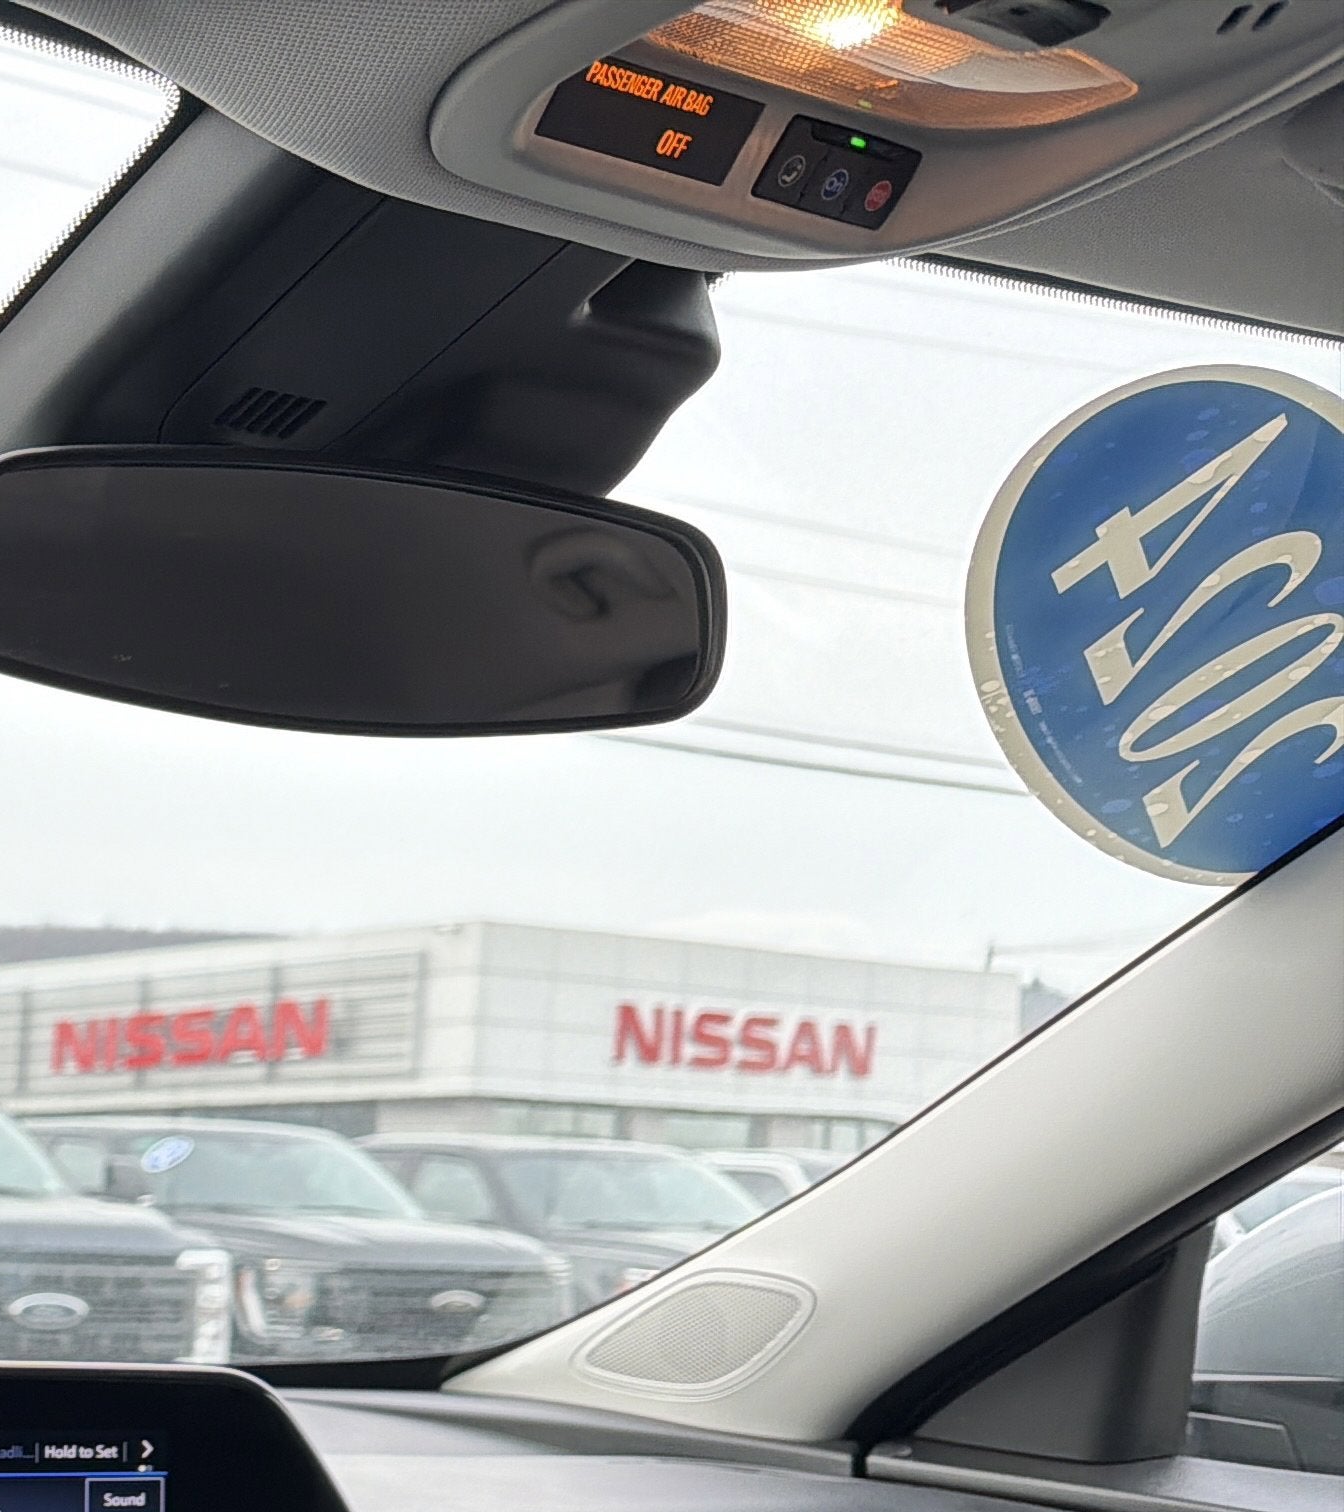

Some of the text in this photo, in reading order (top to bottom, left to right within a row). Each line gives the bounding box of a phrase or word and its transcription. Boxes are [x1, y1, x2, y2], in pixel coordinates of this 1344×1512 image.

[585, 61, 664, 102] PASSENGER
[656, 129, 692, 158] OFF
[52, 999, 330, 1075] NISSAN
[614, 1001, 876, 1077] NISSAN
[44, 1444, 119, 1460] Hold to Set
[103, 1492, 146, 1507] Sound
